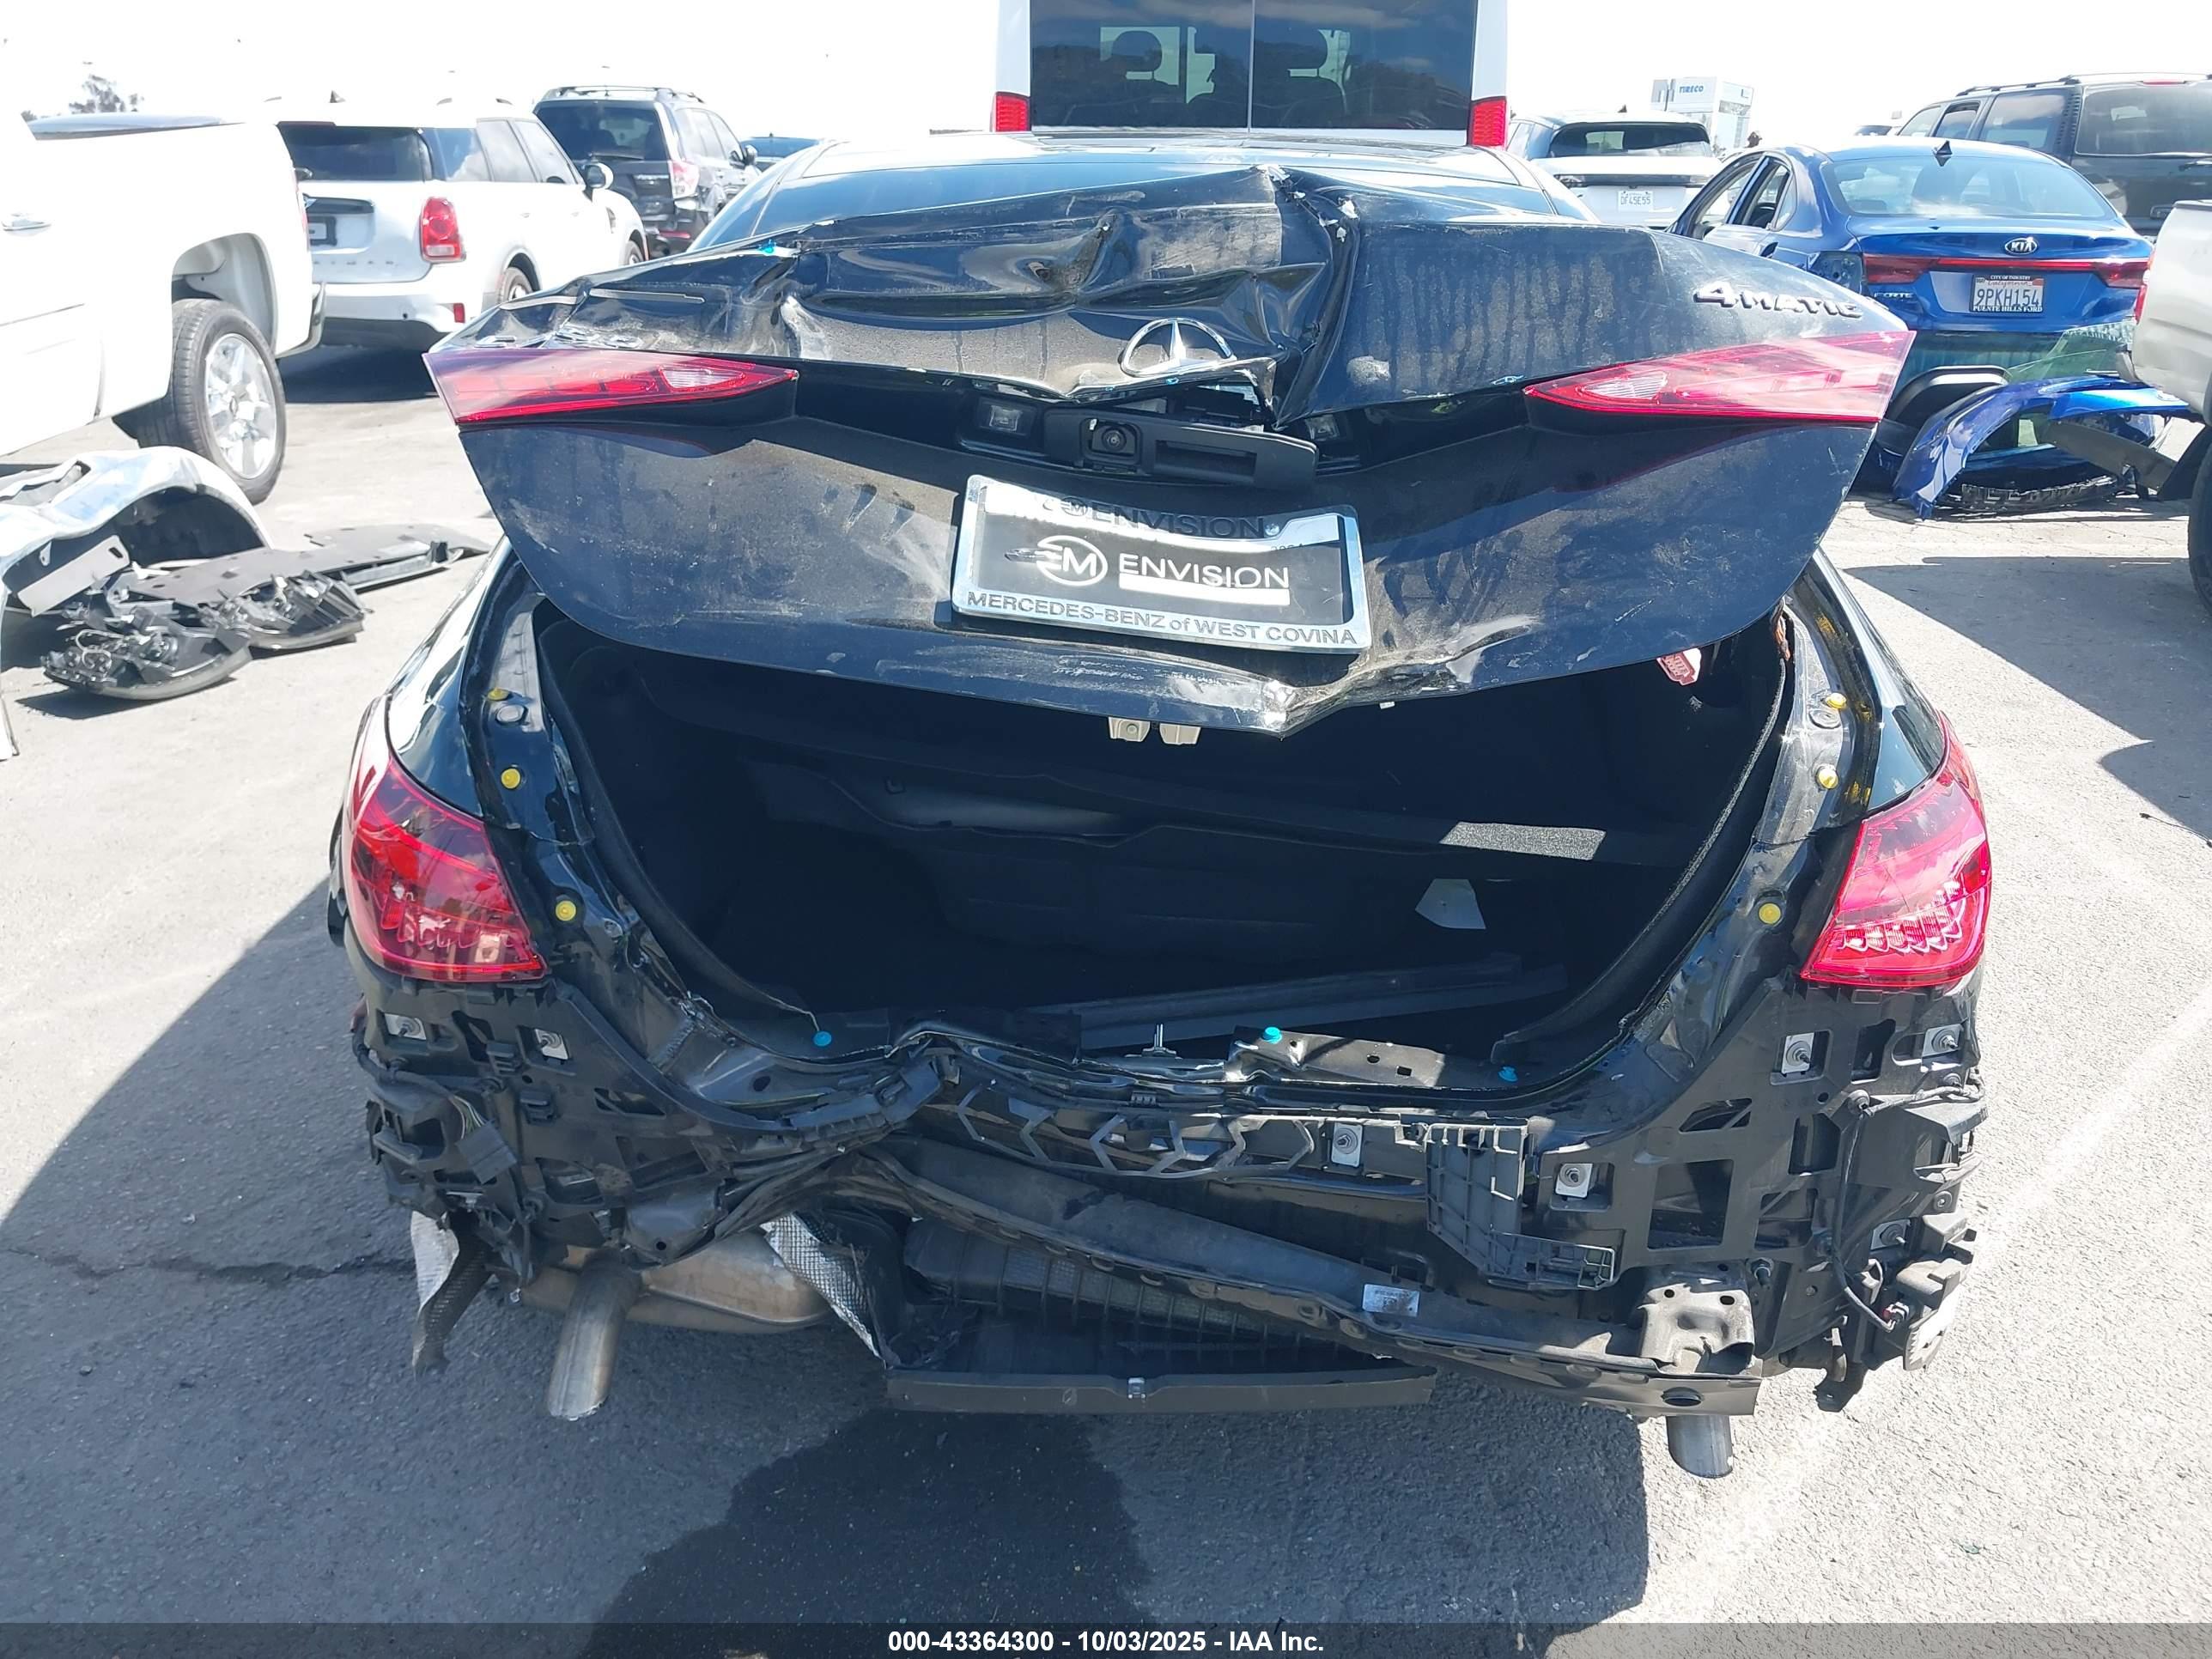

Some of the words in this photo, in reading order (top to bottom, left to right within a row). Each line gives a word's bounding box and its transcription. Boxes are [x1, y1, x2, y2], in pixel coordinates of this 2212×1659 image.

[1679, 85, 1704, 94] TIRECO
[2010, 240, 2033, 252] KIA
[1692, 281, 1863, 319] 4MATIC
[1977, 289, 2039, 307] 9PKH154
[1091, 499, 1267, 539] ENVISION
[1118, 552, 1290, 588] ENVISION
[967, 591, 1166, 629] MERCEDES-BENZ
[1169, 617, 1191, 632] of
[1194, 618, 1261, 640] WEST
[1265, 626, 1358, 645] COVINA
